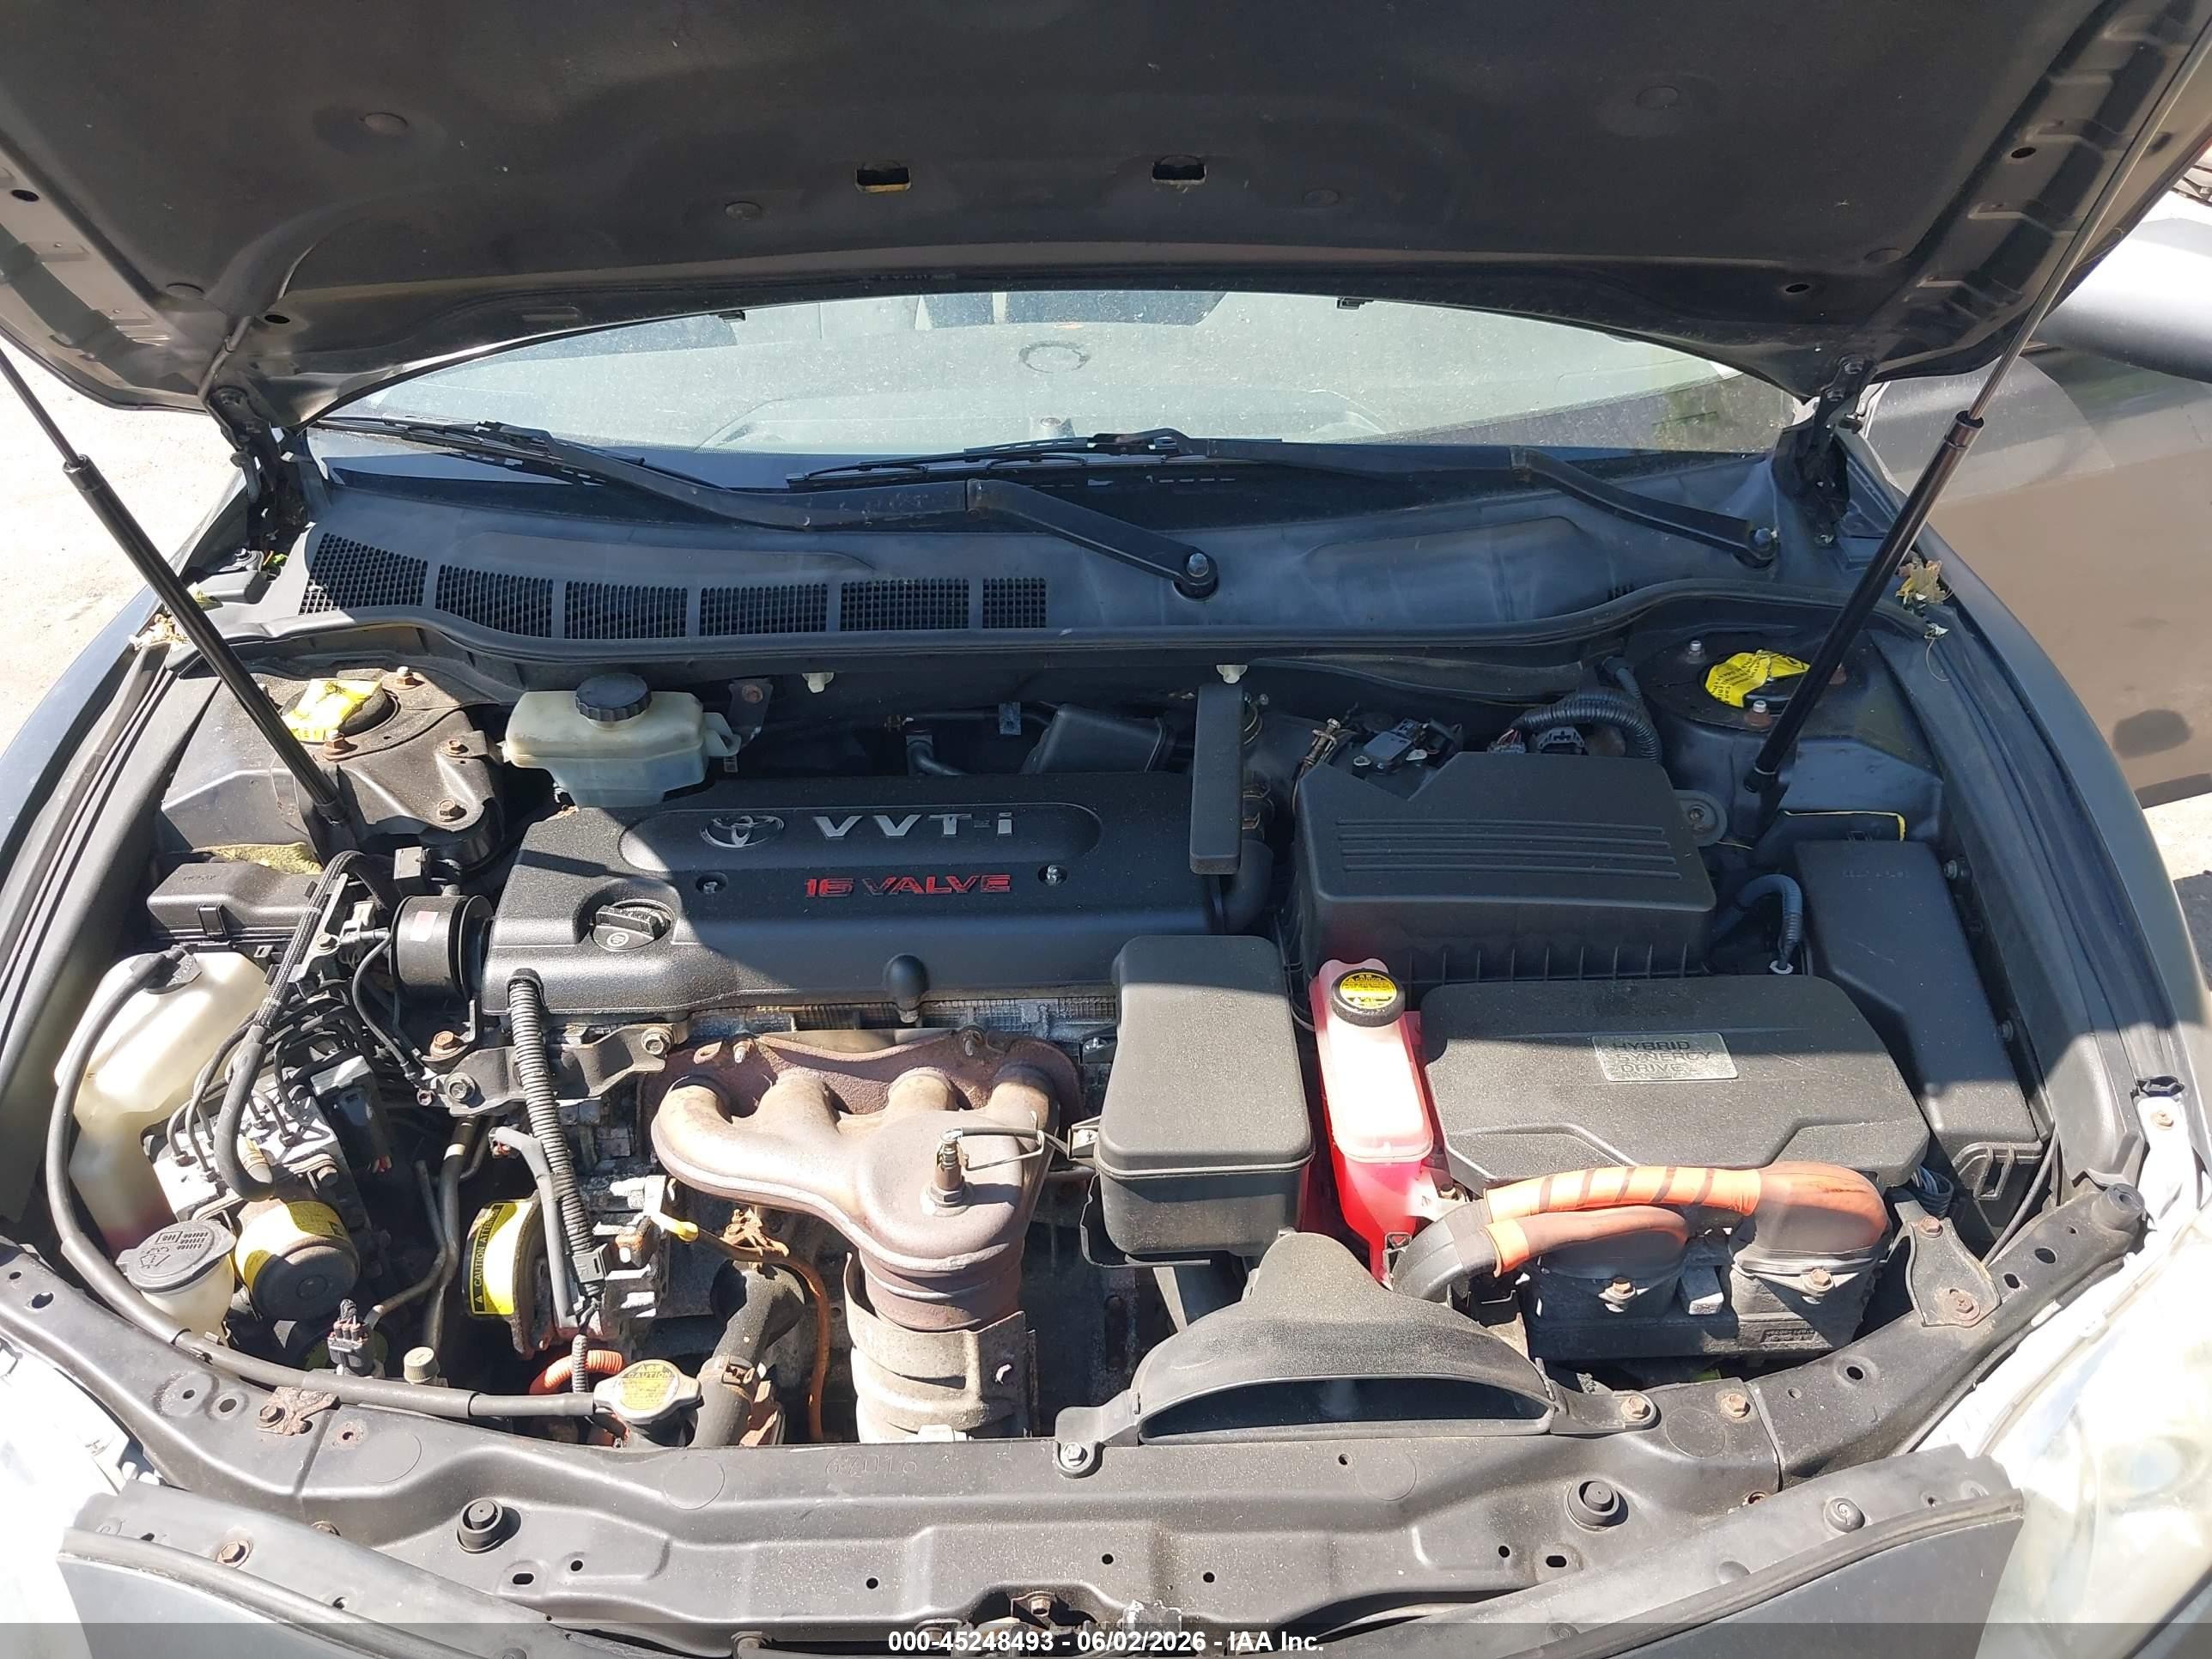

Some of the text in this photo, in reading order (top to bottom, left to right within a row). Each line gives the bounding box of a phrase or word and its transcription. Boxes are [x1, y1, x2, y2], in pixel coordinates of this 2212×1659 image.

[812, 811, 1014, 840] VVT-i
[805, 873, 1012, 897] 16 VALVE
[1613, 1041, 1691, 1051] HYBRID
[1620, 1063, 1686, 1073] DRIVE
[473, 1245, 487, 1287] CAUTION
[628, 1370, 672, 1379] CAUTION
